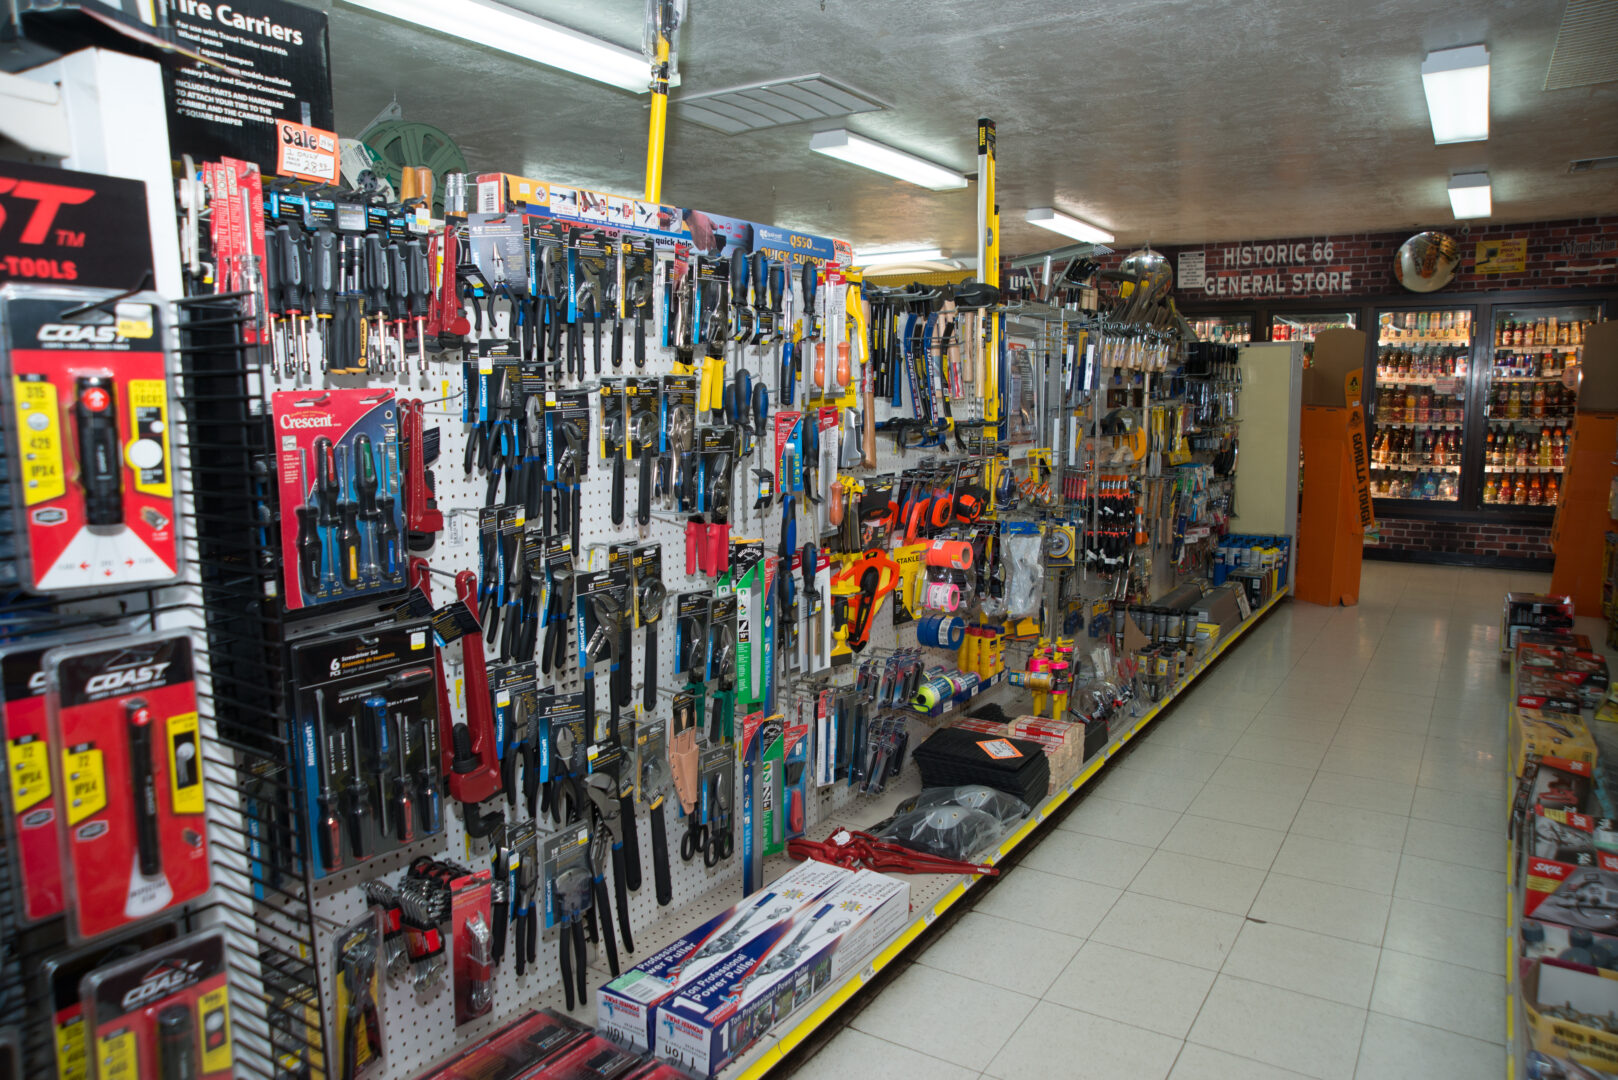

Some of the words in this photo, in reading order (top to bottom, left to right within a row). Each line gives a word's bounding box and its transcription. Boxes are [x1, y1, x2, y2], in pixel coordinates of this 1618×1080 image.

[216, 5, 304, 46] Carriers
[202, 27, 219, 38] with
[218, 31, 240, 43] Travel
[239, 36, 261, 49] Trailer
[260, 42, 274, 53] and
[201, 48, 225, 61] square
[225, 52, 255, 67] bumpers
[203, 70, 221, 83] Duty
[221, 74, 235, 84] and
[257, 83, 296, 99] Construction
[240, 69, 265, 81] models
[264, 72, 292, 87] available
[175, 80, 211, 94] INCLUDES
[210, 86, 233, 98] PARTS
[232, 91, 249, 102] AND
[248, 94, 285, 110] HARDWARE
[175, 88, 187, 97] TO
[187, 92, 215, 104] ATTACH
[214, 96, 235, 108] YOUR
[249, 104, 260, 113] TO
[186, 108, 215, 121] SQUARE
[214, 113, 244, 127] BUMPER
[207, 103, 224, 114] AND
[223, 107, 237, 117] THE
[282, 125, 317, 150] Sale
[655, 237, 676, 247] quick
[790, 234, 813, 250] QS50
[1223, 243, 1307, 267] HISTORIC
[1311, 242, 1335, 262] 66
[1009, 275, 1031, 291] Lite
[1204, 273, 1286, 296] GENERAL
[1292, 271, 1353, 293] STORE
[280, 413, 334, 430] Crescent
[1352, 432, 1367, 484] GORILLA
[1358, 485, 1372, 527] TOUGH
[330, 658, 341, 671] 6
[341, 650, 370, 662] Screwdriver
[370, 647, 379, 656] Set
[85, 661, 171, 694] COAST
[330, 669, 341, 677] PCS
[306, 723, 315, 767] MintCraft
[1533, 862, 1564, 876] SKIL
[637, 939, 688, 971] Professional
[665, 942, 697, 963] Puller
[681, 985, 702, 999] Ton
[700, 953, 748, 988] Professional
[691, 978, 728, 1003] Power
[725, 958, 757, 980] Puller
[671, 994, 710, 1015] 1
[719, 1021, 730, 1052] 1
[742, 988, 777, 1019] Professional
